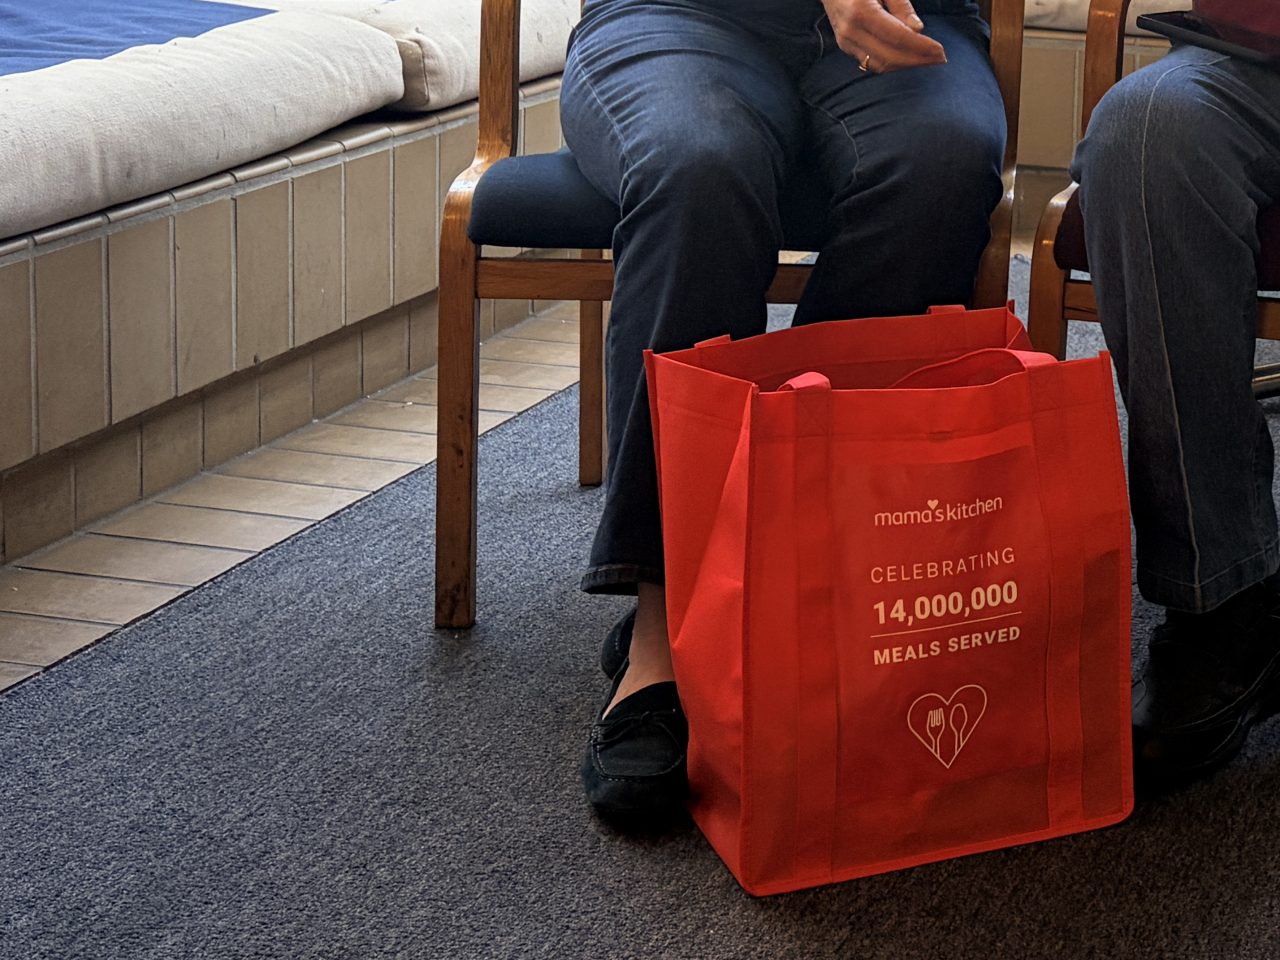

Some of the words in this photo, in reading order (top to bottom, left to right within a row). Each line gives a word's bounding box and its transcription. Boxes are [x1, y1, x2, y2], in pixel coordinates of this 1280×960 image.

[946, 496, 1003, 521] kitchen
[870, 547, 1016, 584] CELEBRATING
[873, 580, 1018, 627] 14,000,000
[873, 640, 942, 666] MEALS
[947, 626, 1021, 653] SERVED
